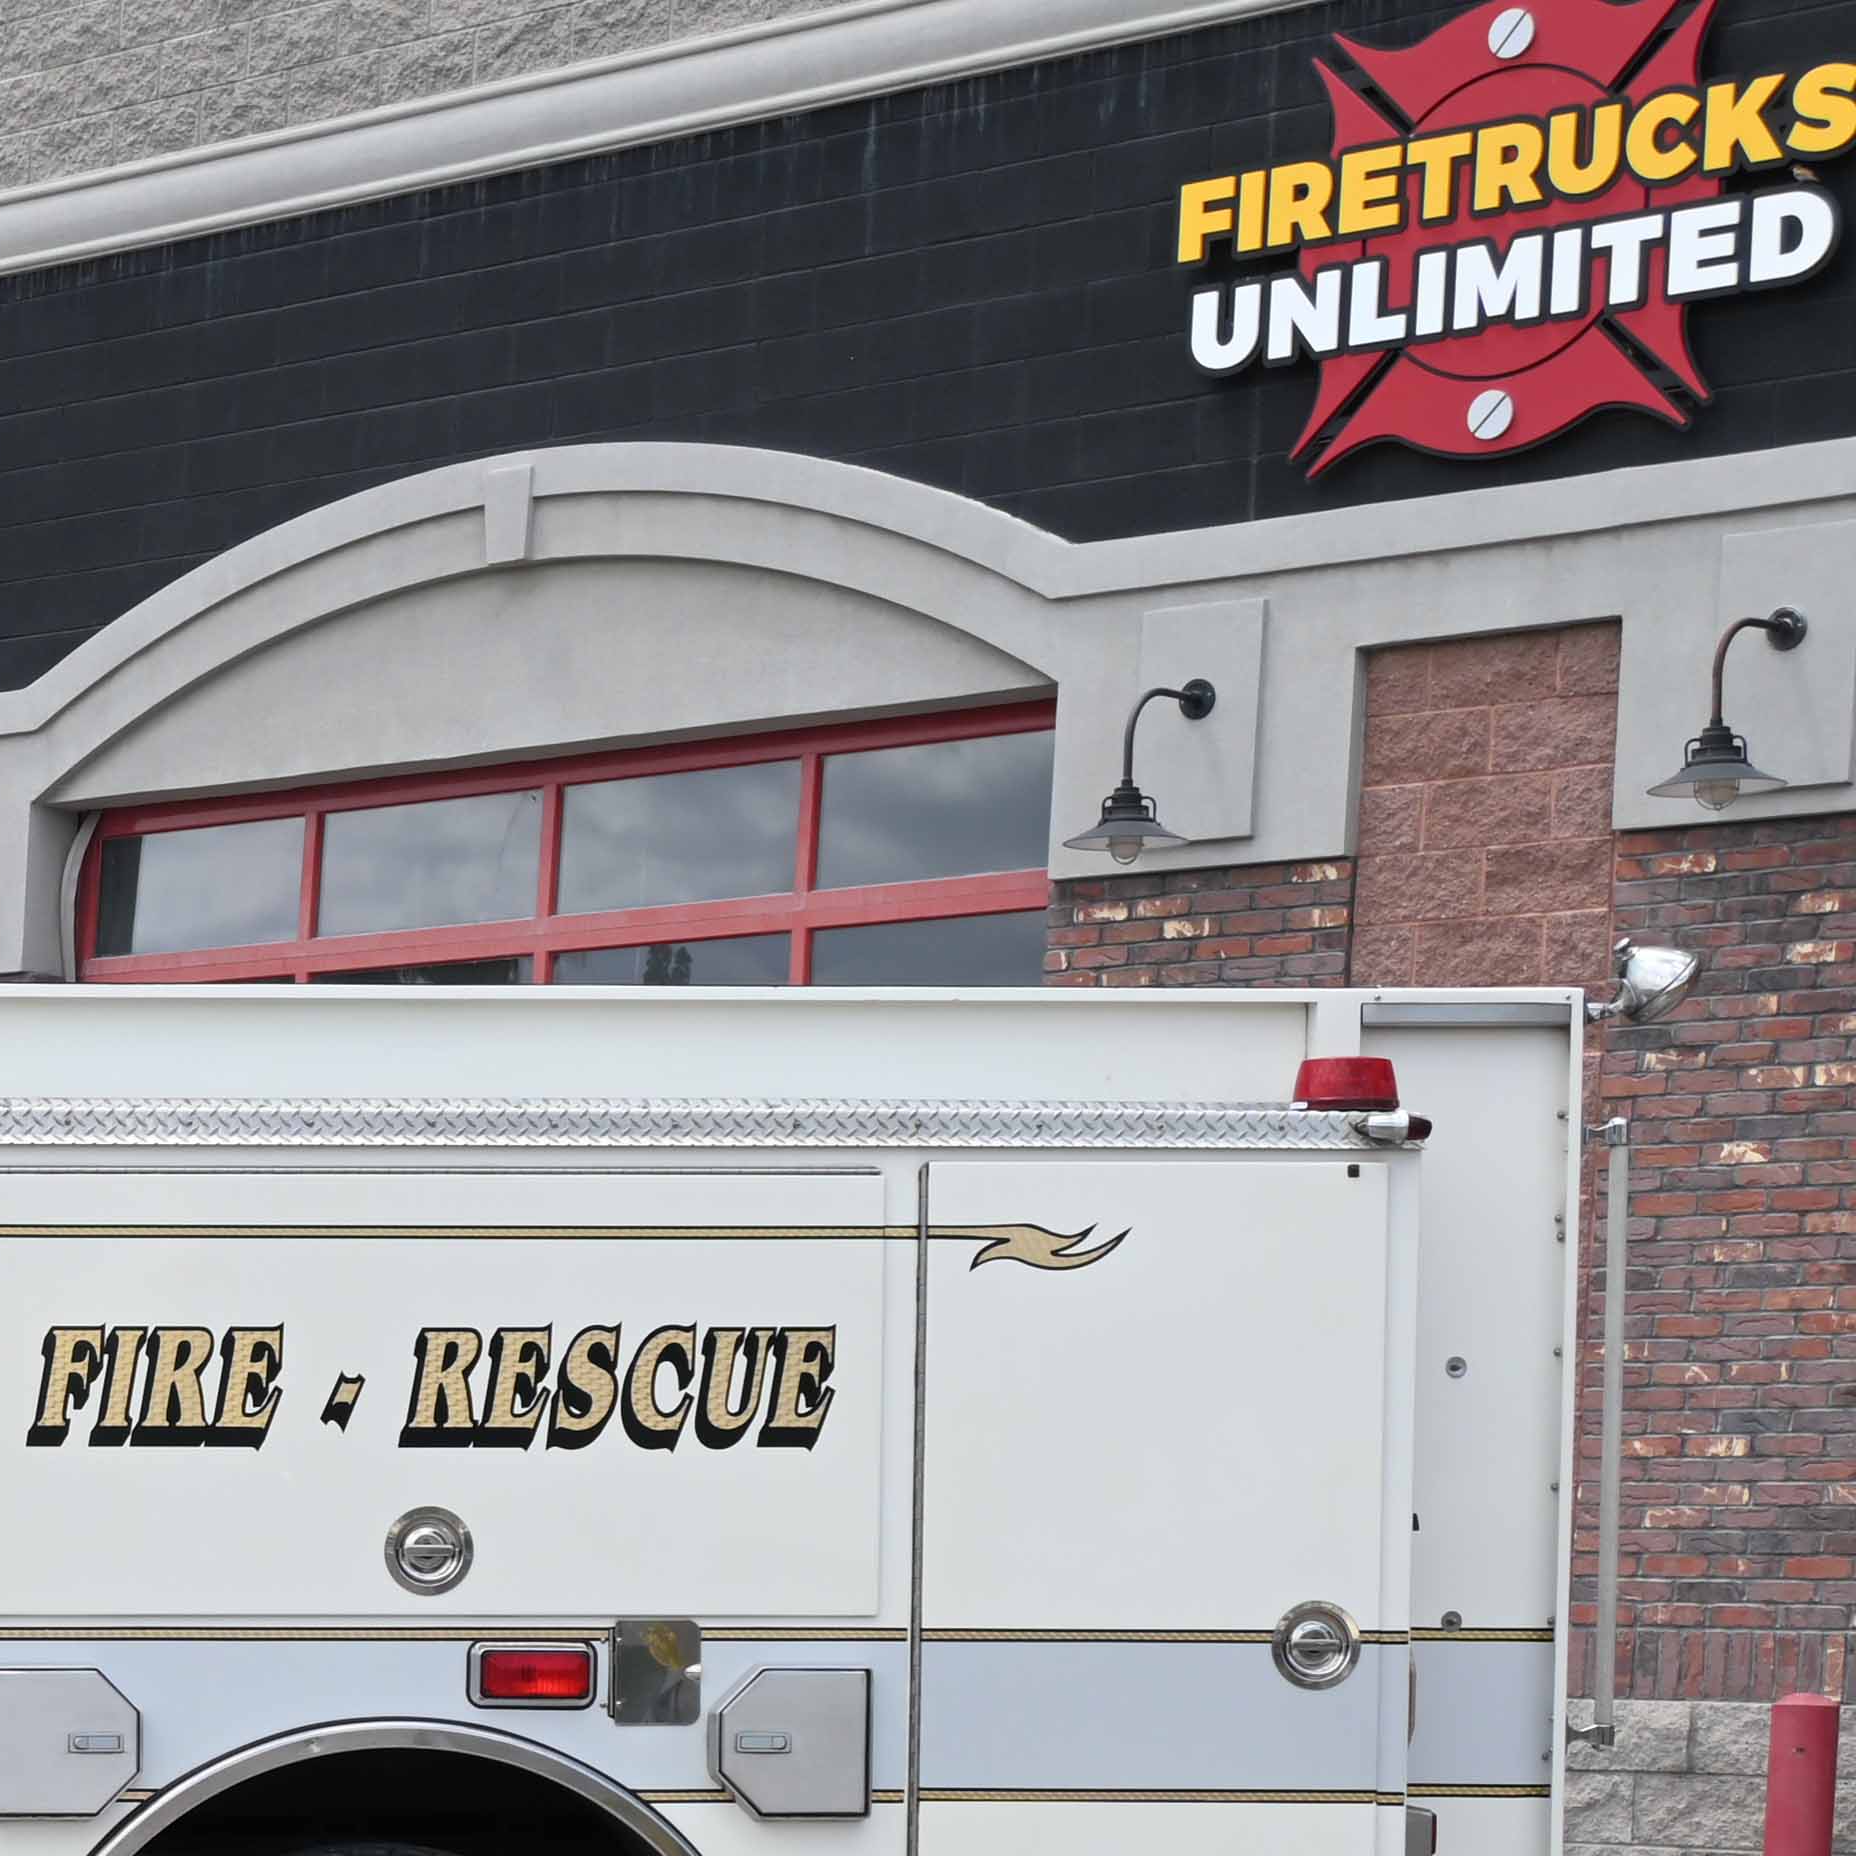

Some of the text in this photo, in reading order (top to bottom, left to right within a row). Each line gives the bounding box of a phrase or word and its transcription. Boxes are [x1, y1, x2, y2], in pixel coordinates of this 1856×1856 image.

[1177, 62, 1856, 263] FIRETRUCKS
[1191, 190, 1834, 370] UNLIMITED
[26, 1322, 284, 1451] FIRE
[398, 1322, 837, 1452] RESCUE
